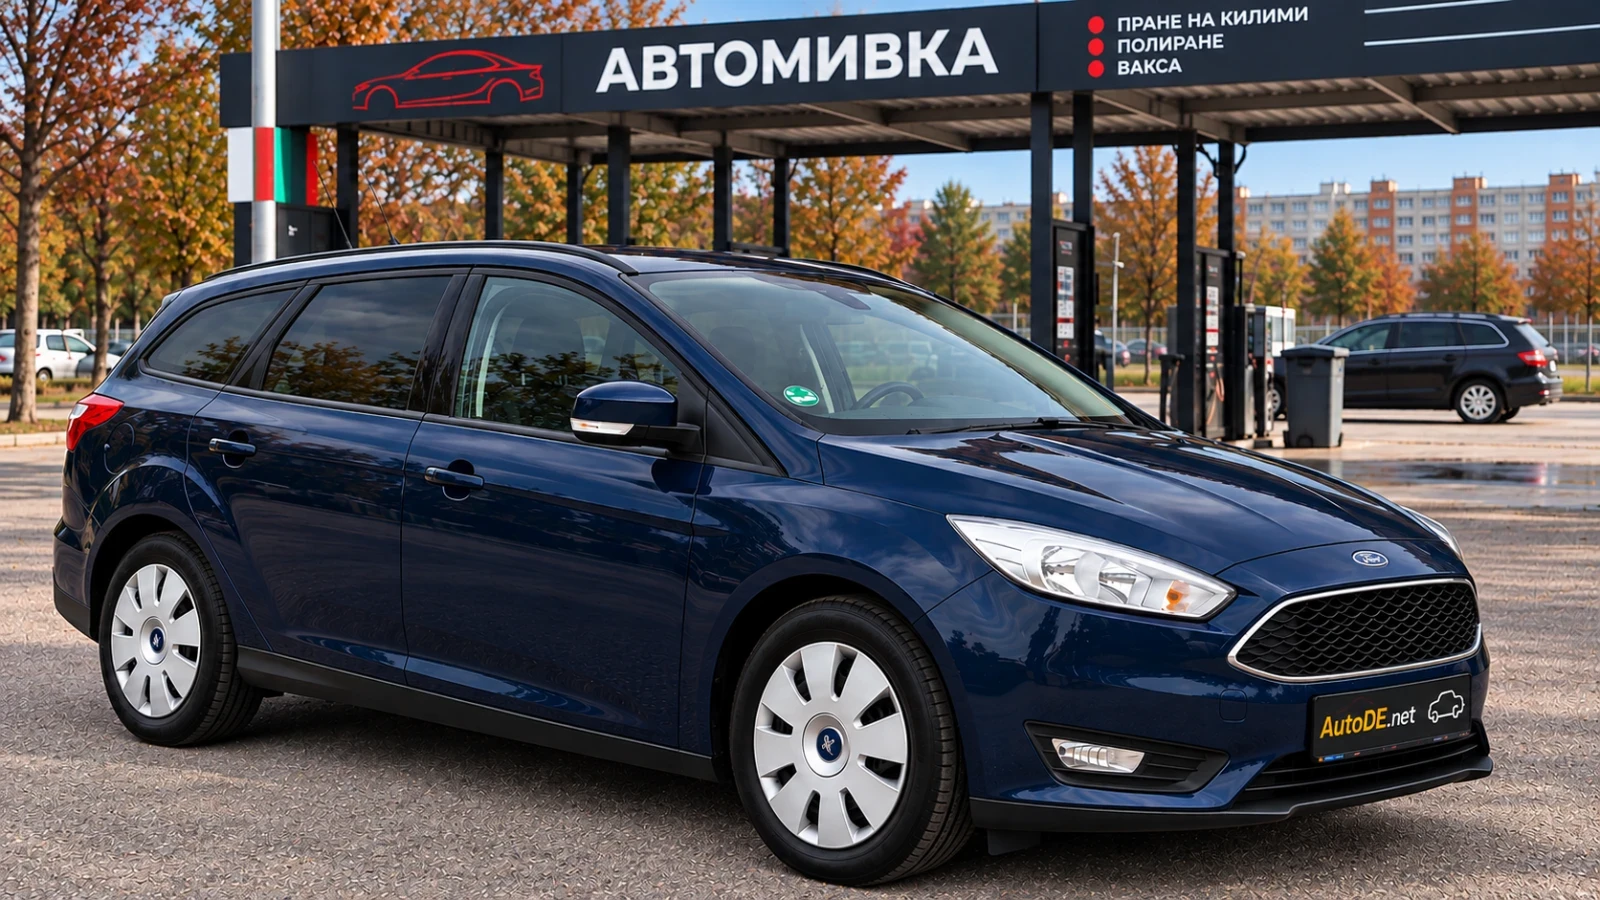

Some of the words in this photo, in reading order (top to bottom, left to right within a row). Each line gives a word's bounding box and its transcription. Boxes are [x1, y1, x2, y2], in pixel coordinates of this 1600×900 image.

[1117, 14, 1182, 32] ПРАНЕ
[1187, 12, 1216, 28] НА
[1220, 6, 1309, 26] КИЛИМИ
[1117, 33, 1224, 54] ПОЛИРАНЕ
[595, 27, 999, 93] АВТОМИВКА
[1117, 57, 1183, 76] ВАКСА
[1319, 705, 1417, 739] AutoDE.net
